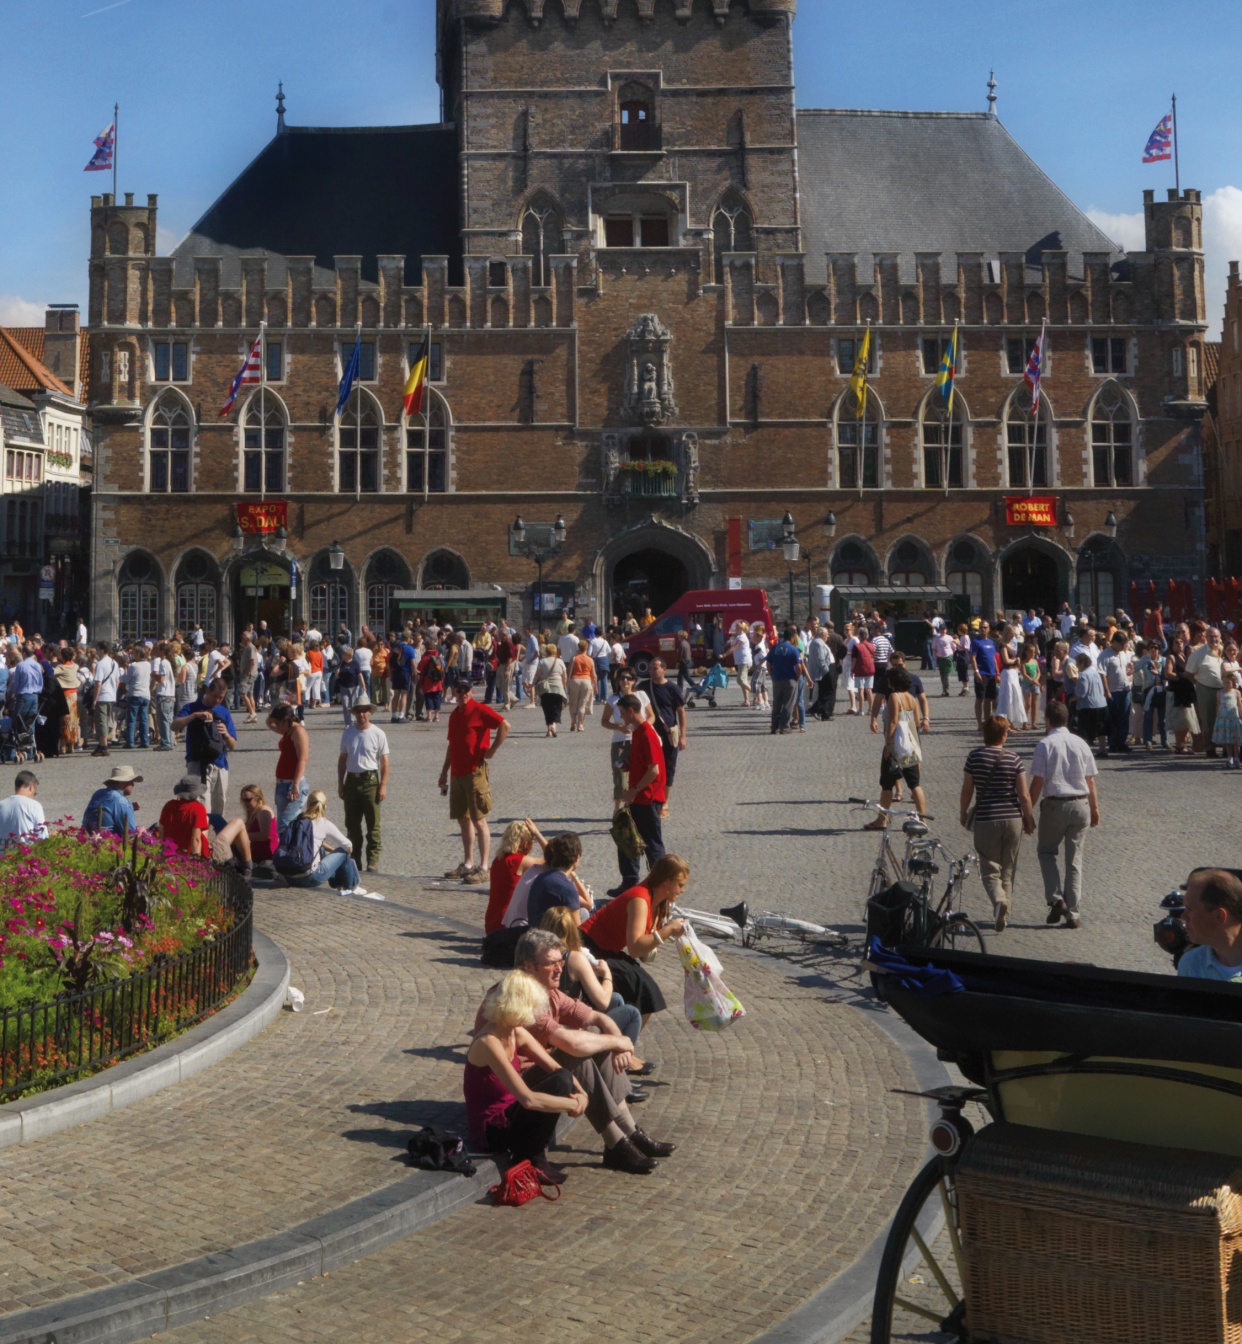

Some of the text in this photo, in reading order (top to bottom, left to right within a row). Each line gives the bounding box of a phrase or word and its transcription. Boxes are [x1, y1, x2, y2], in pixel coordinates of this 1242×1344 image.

[248, 505, 276, 514] EXPO
[1012, 502, 1050, 512] ROBERT
[256, 515, 285, 528] DALI
[1013, 513, 1051, 522] DE MAN
